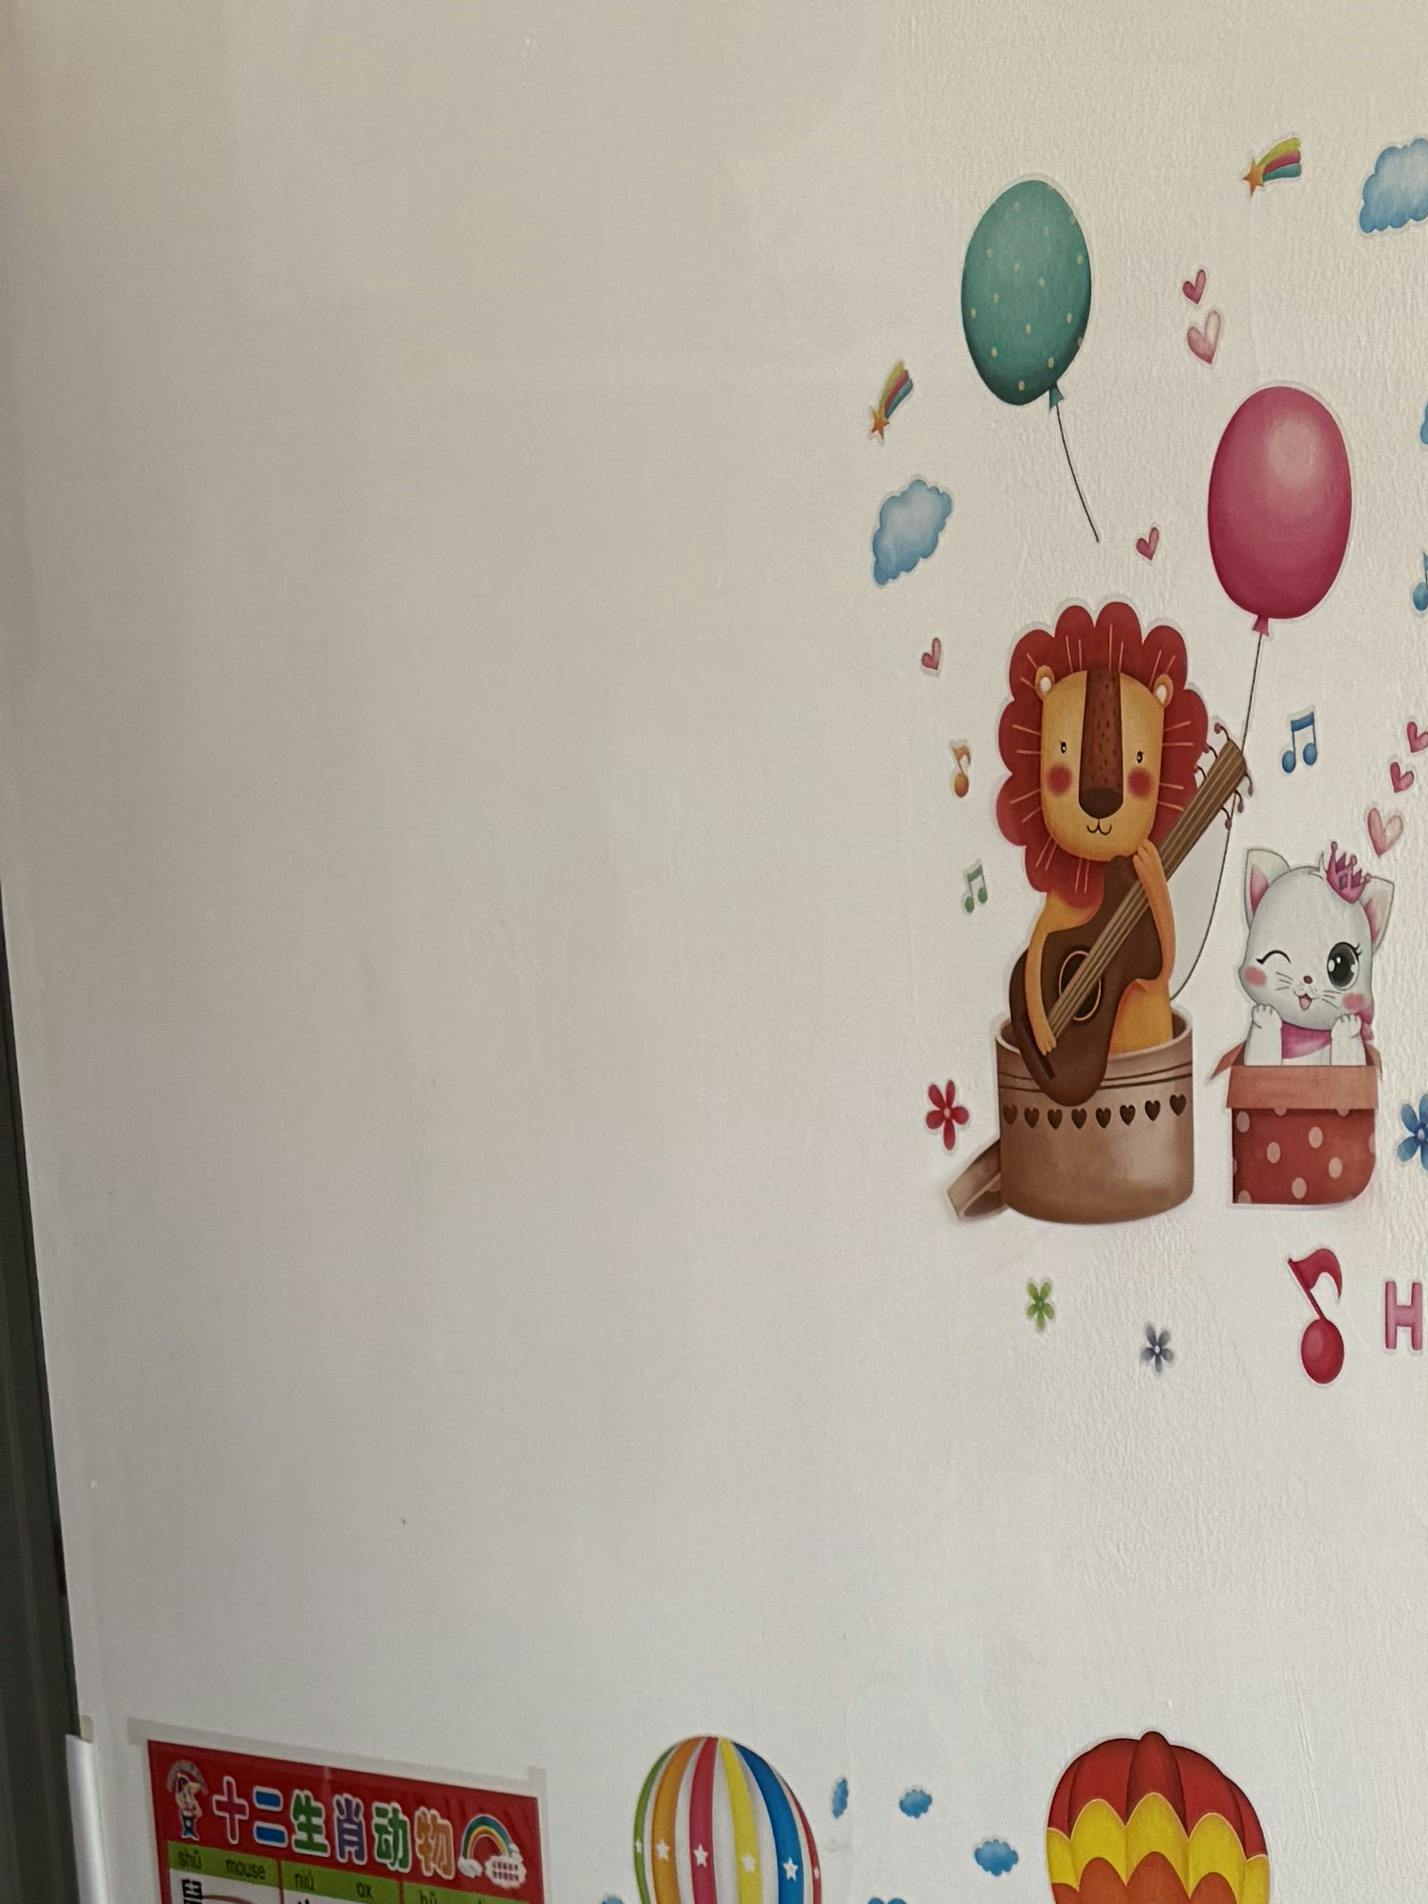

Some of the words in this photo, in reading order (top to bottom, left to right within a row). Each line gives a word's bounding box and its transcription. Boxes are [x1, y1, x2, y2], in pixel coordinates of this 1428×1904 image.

[212, 1776, 456, 1879] 十二生肖动物
[225, 1859, 267, 1880] mouse
[357, 1882, 374, 1899] ox
